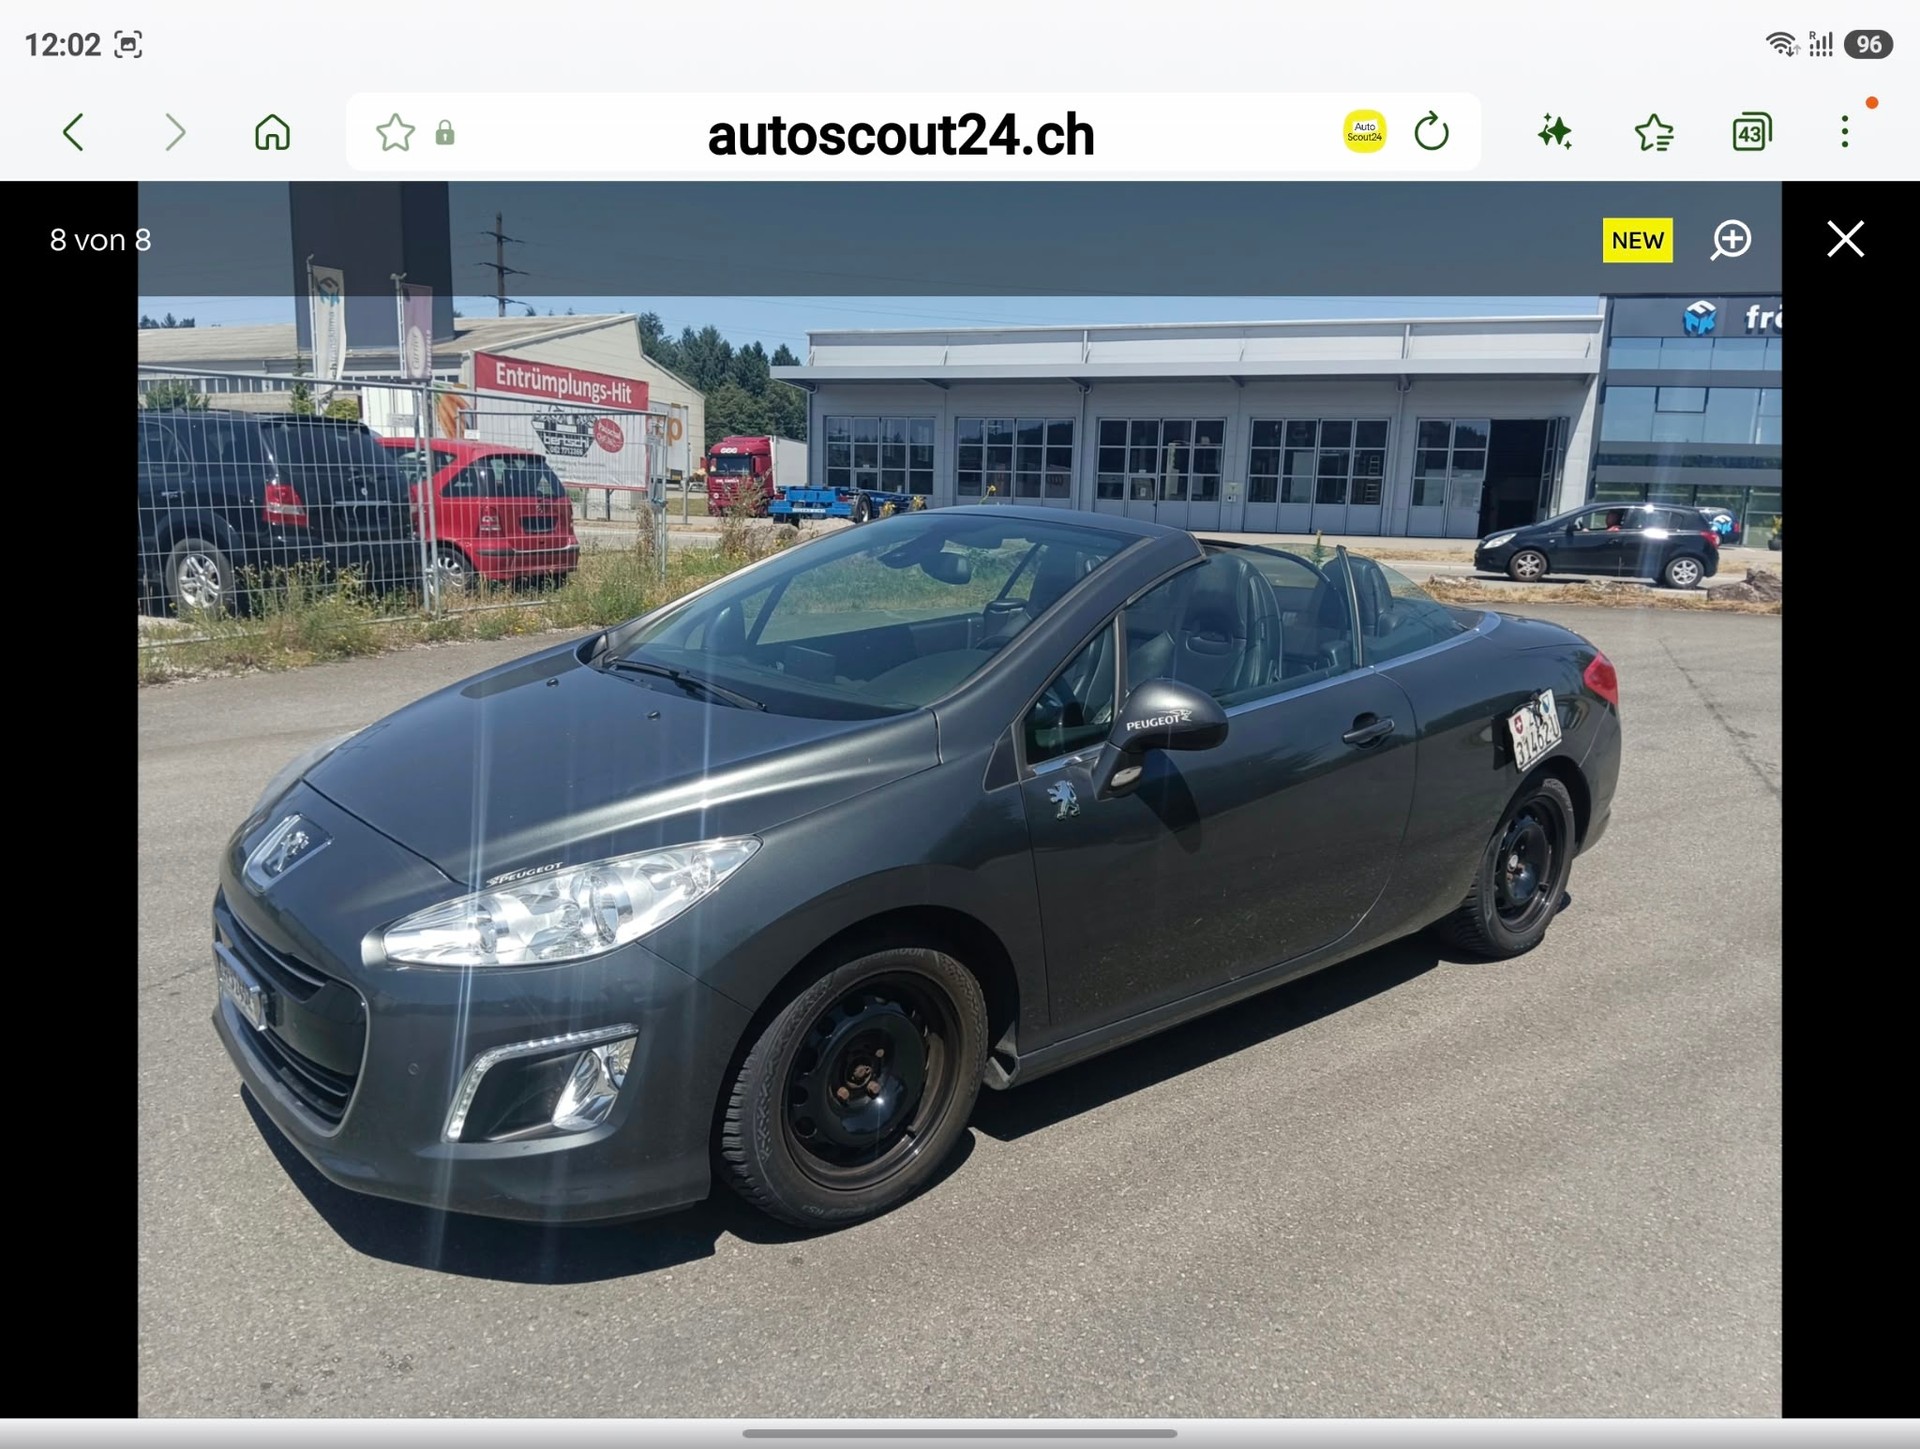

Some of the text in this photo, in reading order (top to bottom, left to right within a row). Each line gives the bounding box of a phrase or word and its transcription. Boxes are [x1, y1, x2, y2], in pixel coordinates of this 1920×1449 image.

[495, 361, 632, 404] Entrümplungs-Hit
[543, 433, 590, 449] bertschi
[1126, 715, 1180, 732] PEUGEOT
[498, 861, 564, 884] PEUGEOT
